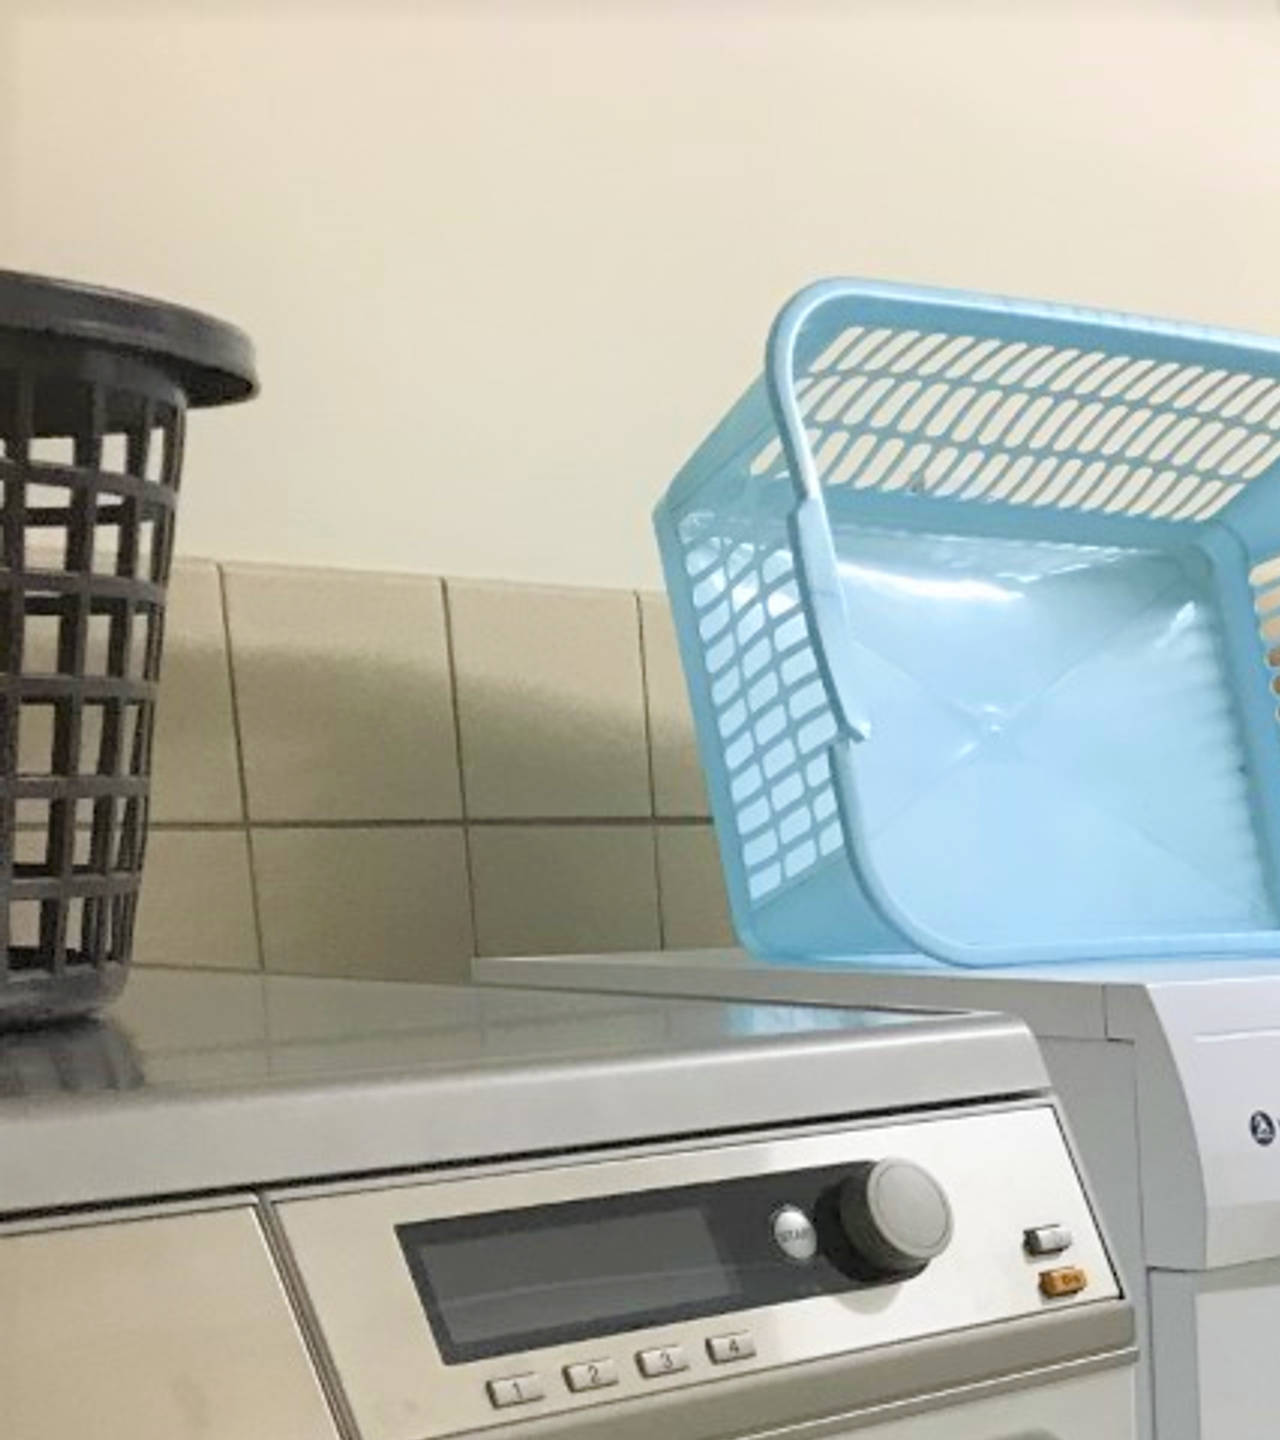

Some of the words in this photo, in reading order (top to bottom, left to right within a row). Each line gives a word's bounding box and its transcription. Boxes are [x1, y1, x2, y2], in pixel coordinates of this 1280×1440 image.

[728, 1338, 741, 1356] 4
[660, 1351, 674, 1370] 3
[588, 1366, 601, 1385] 2
[513, 1381, 525, 1402] 1
